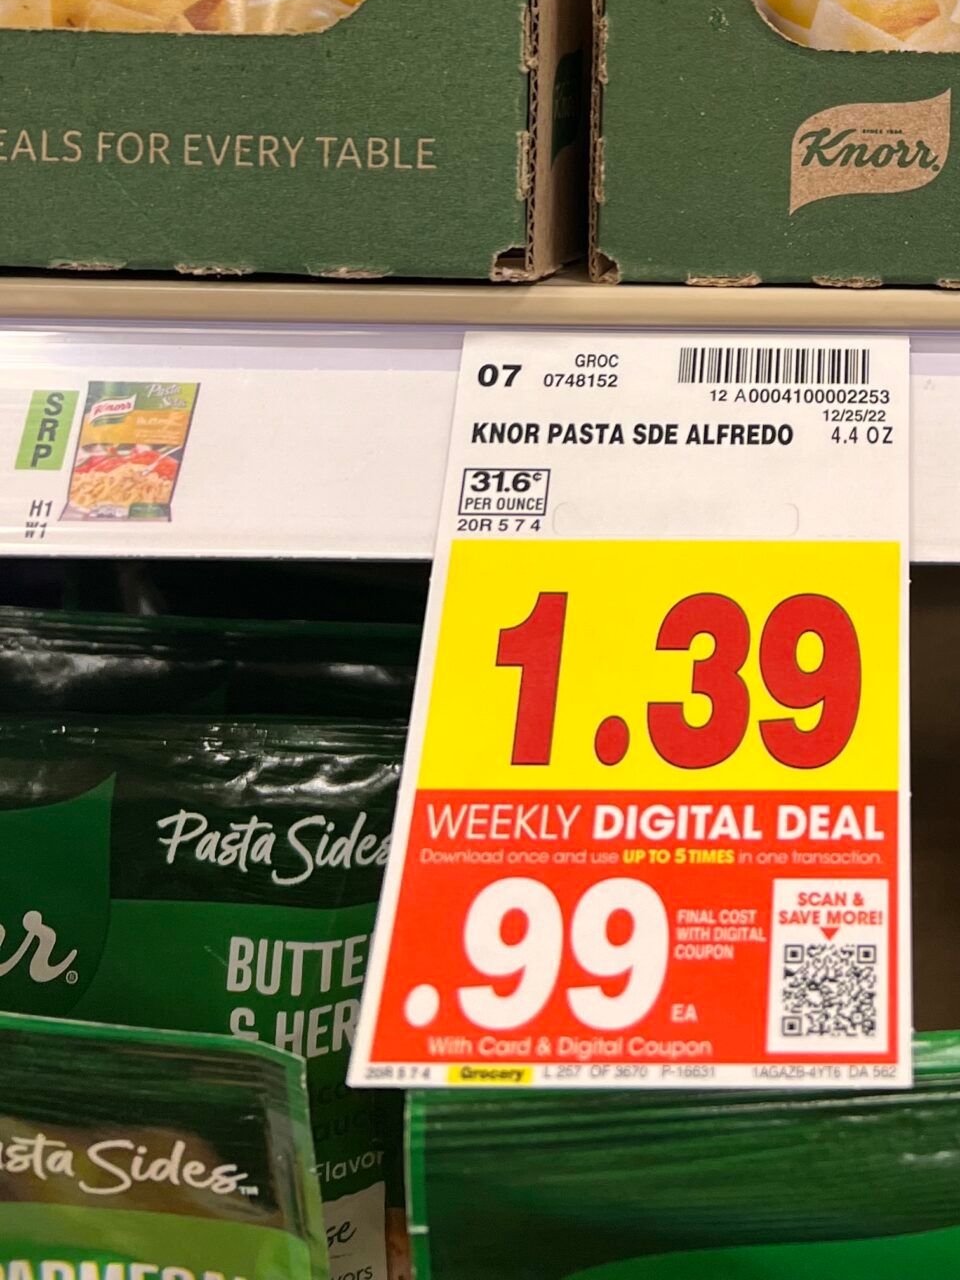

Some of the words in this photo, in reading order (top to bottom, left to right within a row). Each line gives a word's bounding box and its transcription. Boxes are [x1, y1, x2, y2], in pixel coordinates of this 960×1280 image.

[96, 131, 171, 165] FOR
[183, 133, 305, 169] EVERY
[315, 136, 438, 170] TABLE
[799, 127, 938, 169] Knorr
[574, 353, 620, 369] GROC
[476, 363, 522, 389] 07
[543, 373, 619, 389] 0748152
[709, 389, 728, 403] 12
[734, 388, 891, 405] A0004100002253
[822, 409, 887, 423] 12/25/22
[471, 422, 541, 445] KNOR
[547, 422, 625, 445] PASTA
[632, 423, 678, 445] SDE
[686, 423, 795, 446] ALFREDO
[831, 425, 859, 445] 4.4
[866, 426, 894, 445] OZ
[29, 499, 53, 518] H1
[465, 497, 492, 511] PER
[496, 497, 545, 512] OUNCE
[457, 518, 492, 533] 20R
[498, 519, 509, 533] 5
[513, 519, 525, 533] 7
[530, 519, 541, 533] 4
[495, 592, 863, 770] 1.39
[426, 803, 582, 841] WEEKLY
[592, 804, 763, 841] DIGITAL
[776, 804, 886, 841] DEAL
[156, 808, 277, 873] Pasta
[420, 847, 504, 864] Download
[507, 849, 550, 864] once
[553, 847, 587, 864] and
[591, 850, 619, 864] use
[622, 848, 646, 864] UP
[648, 848, 671, 864] TO
[674, 847, 687, 864] 5
[689, 848, 735, 864] TIMES
[738, 849, 753, 864] in
[756, 851, 788, 864] one
[797, 892, 847, 907] SCAN
[853, 892, 864, 907] &
[677, 908, 716, 924] FINAL
[718, 908, 758, 924] COST
[778, 909, 821, 925] SAVE
[826, 910, 883, 926] MORE!
[676, 926, 711, 941] WITH
[713, 926, 767, 942] DIGITAL
[403, 876, 669, 1031] .99
[674, 943, 734, 960] COUPON
[226, 933, 376, 996] BUTTE
[671, 1004, 698, 1023] EA
[427, 1035, 474, 1056] With
[478, 1035, 532, 1056] Card
[535, 1036, 552, 1056] &
[557, 1036, 624, 1061] Digital
[627, 1036, 713, 1058] Coupon
[459, 1065, 525, 1082] Grocery
[589, 1065, 608, 1078] OF
[78, 1138, 249, 1195] Sides
